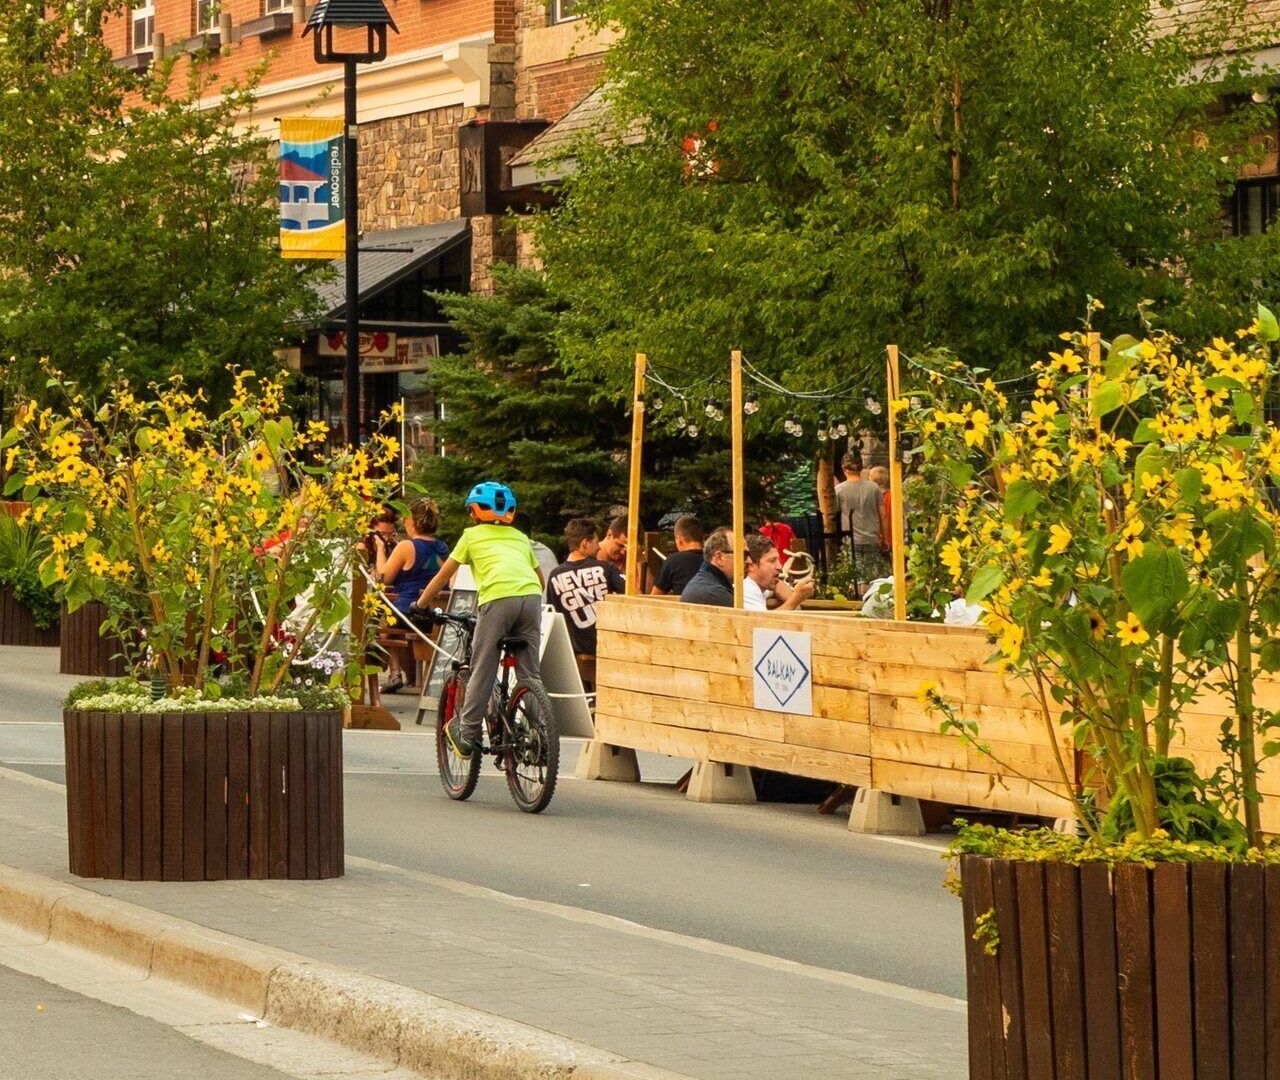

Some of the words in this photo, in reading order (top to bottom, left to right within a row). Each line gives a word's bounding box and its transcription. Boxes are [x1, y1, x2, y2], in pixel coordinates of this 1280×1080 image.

[331, 146, 341, 208] rediscover
[551, 566, 607, 595] NEVER
[561, 583, 608, 612] GIVE
[570, 602, 597, 629] U
[767, 658, 796, 682] BALKAN
